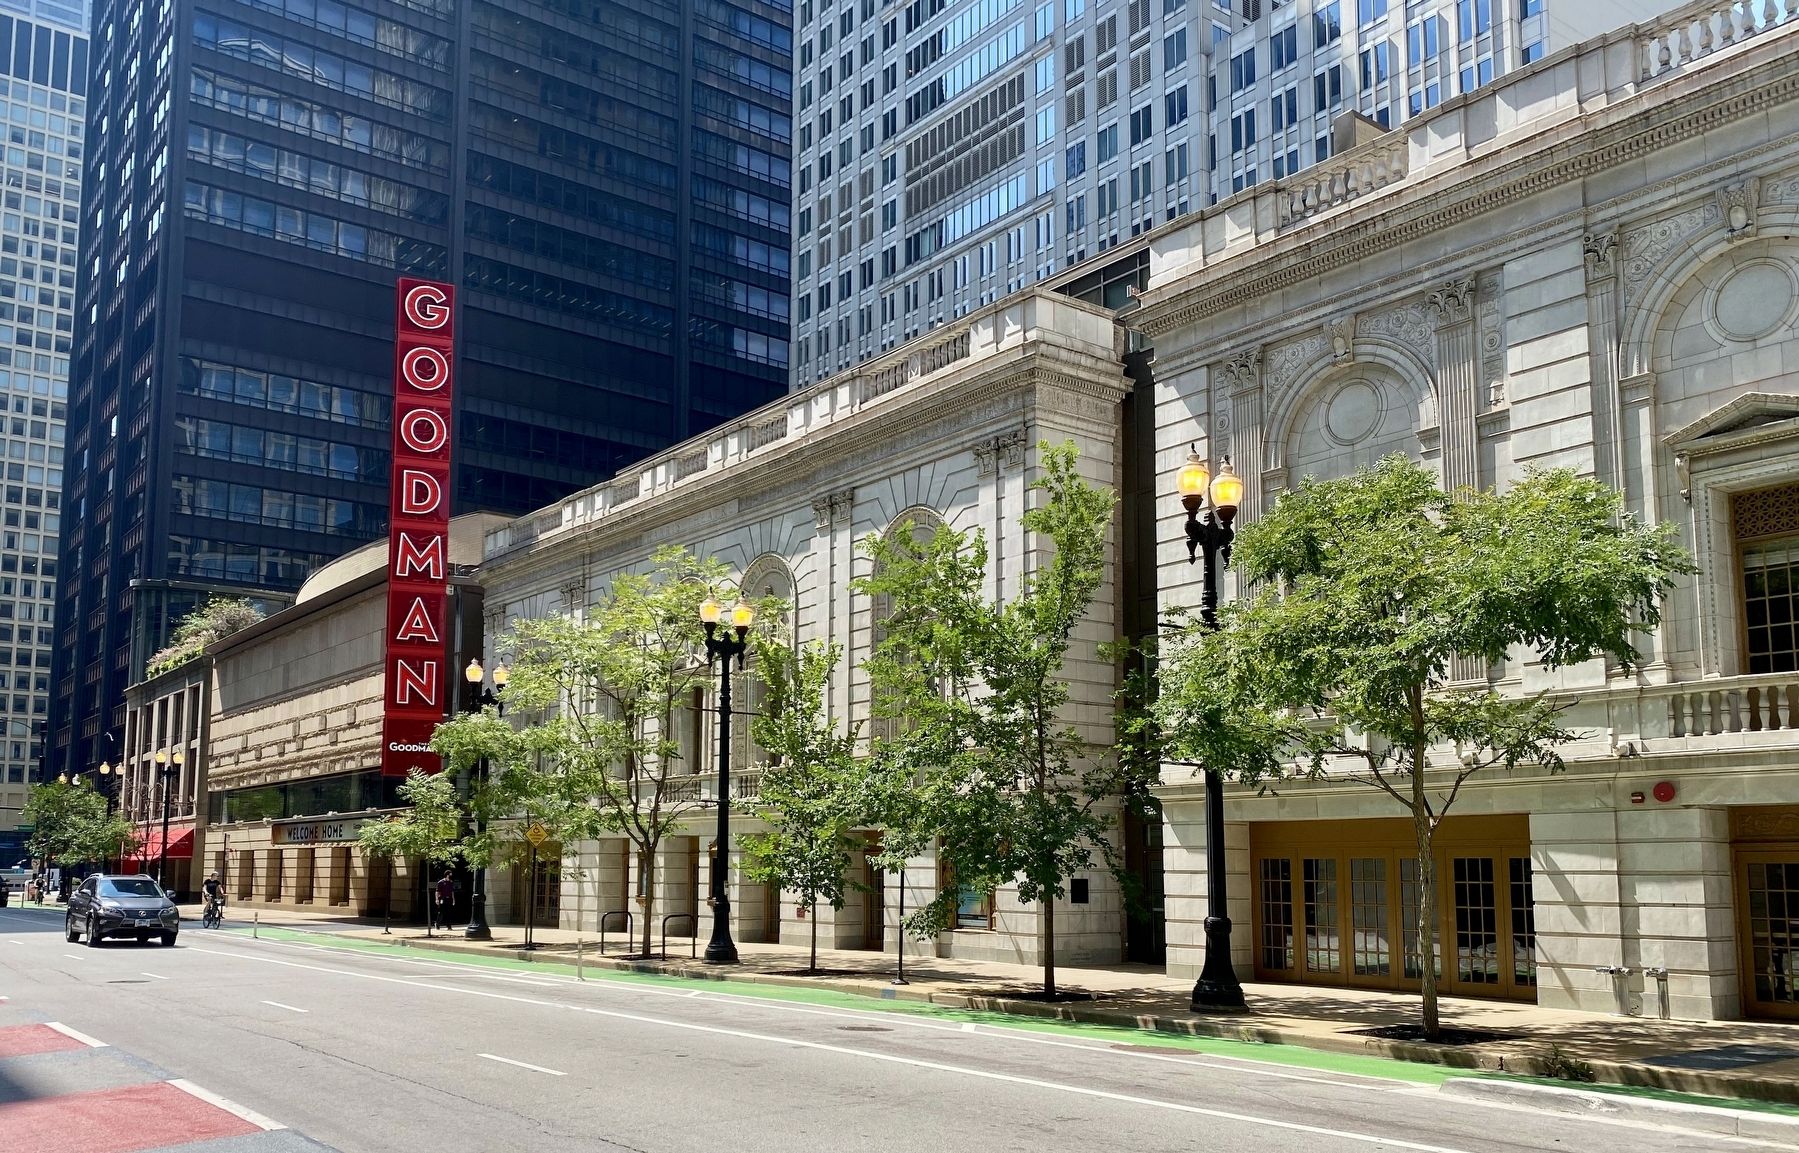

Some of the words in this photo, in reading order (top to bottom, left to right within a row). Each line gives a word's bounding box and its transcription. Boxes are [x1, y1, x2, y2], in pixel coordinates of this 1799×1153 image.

[396, 286, 449, 706] GOODMAN
[389, 742, 433, 752] GOODMA
[287, 825, 318, 840] WELCOME
[322, 824, 343, 838] HOME
